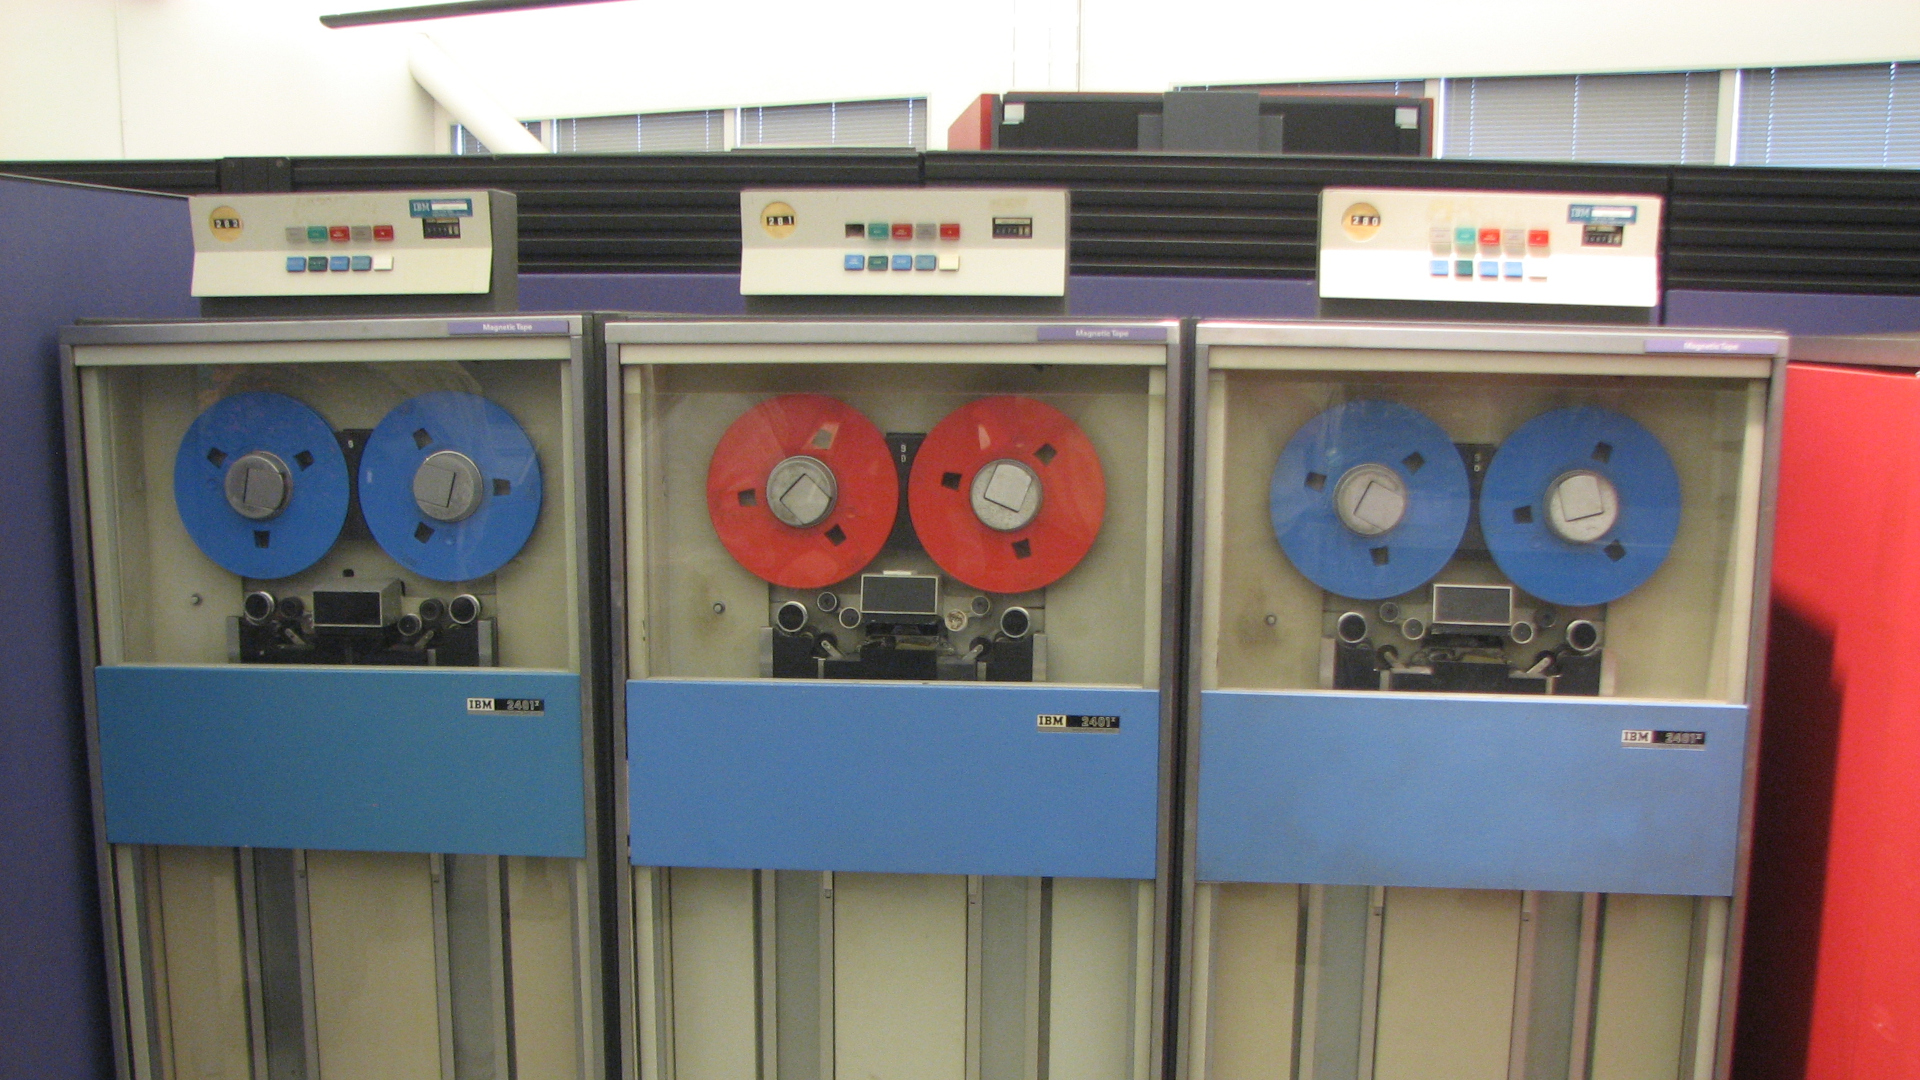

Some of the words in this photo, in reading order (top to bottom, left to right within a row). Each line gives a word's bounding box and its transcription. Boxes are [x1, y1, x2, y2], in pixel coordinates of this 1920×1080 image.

[768, 216, 792, 226] 281
[1352, 216, 1379, 226] 280
[482, 323, 515, 333] Magnetic
[516, 322, 533, 332] Tape
[1075, 329, 1111, 339] Magnetic
[1112, 329, 1130, 338] Tape
[468, 699, 492, 709] IBM
[1038, 715, 1063, 726] IBM
[1623, 731, 1649, 742] IBM
